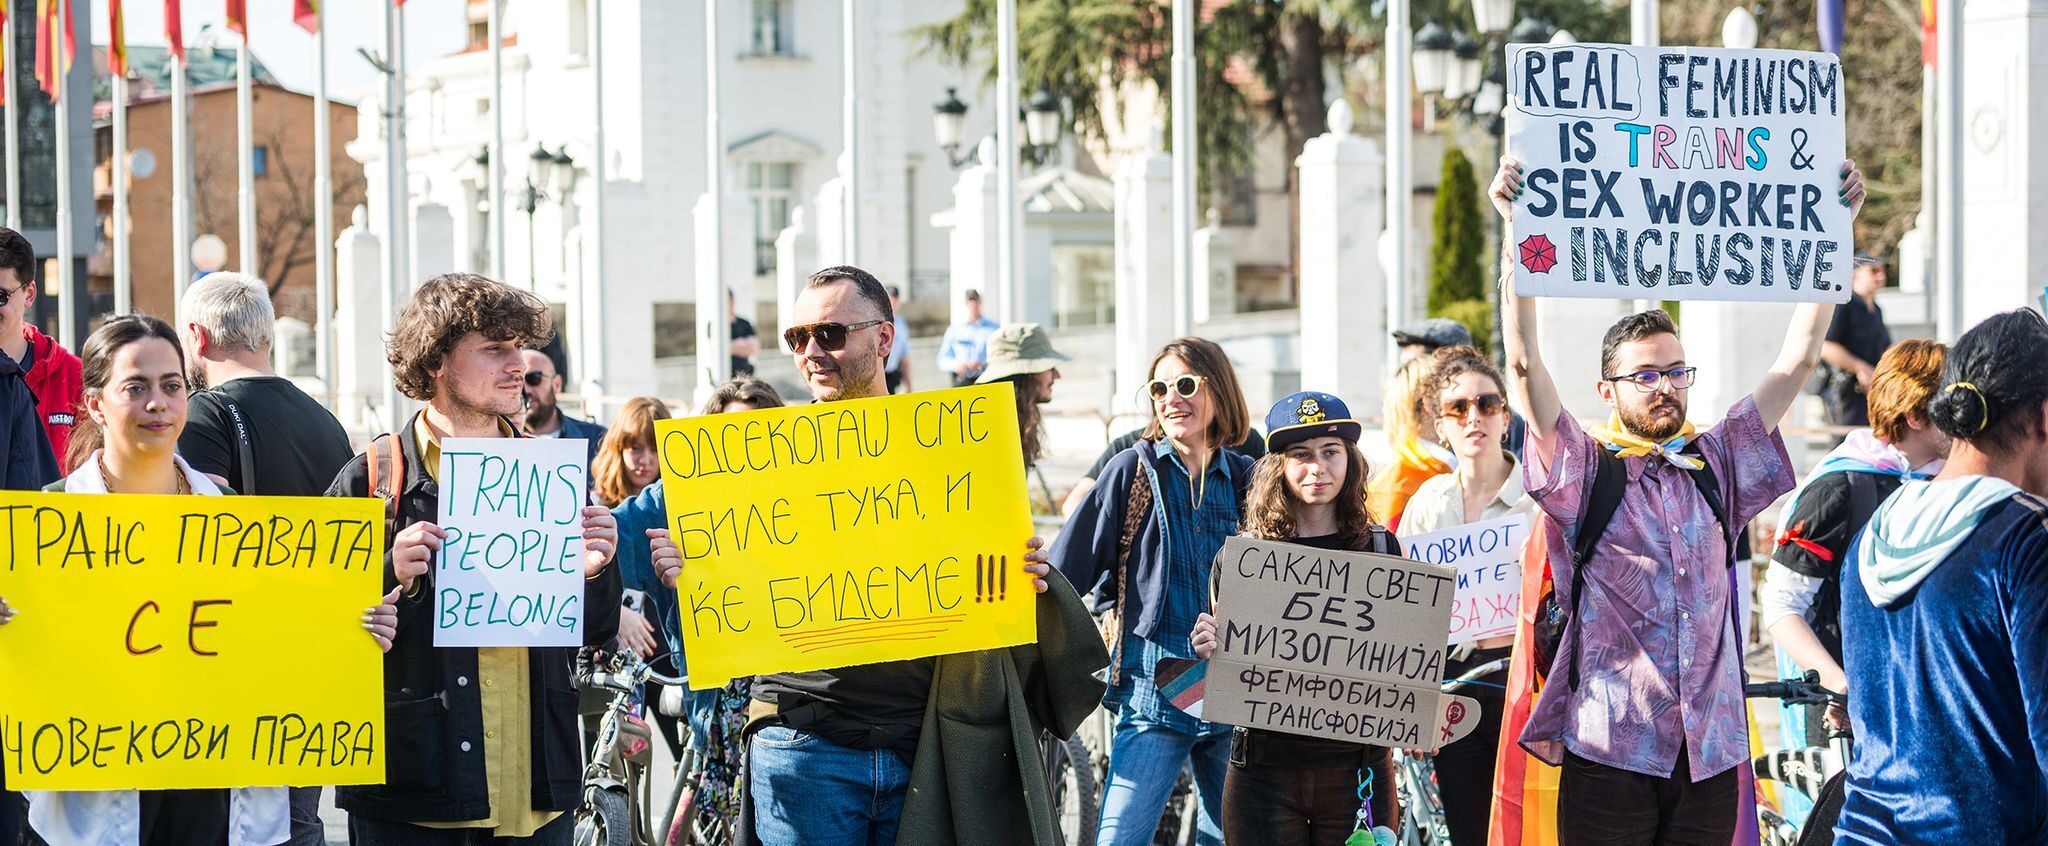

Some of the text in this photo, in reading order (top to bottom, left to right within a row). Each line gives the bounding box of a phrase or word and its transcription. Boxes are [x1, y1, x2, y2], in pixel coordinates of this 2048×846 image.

[1525, 51, 1838, 117] REAL FEMINISM
[1559, 120, 1816, 171] IS TRANS &
[1526, 168, 1826, 234] SEX WORKER
[1570, 226, 1843, 292] INCLUSIVE.
[663, 396, 989, 479] ОДСЕКОГАШ СМЕ
[442, 452, 582, 525] TRANS
[677, 471, 972, 560] БИЛЕ ТУКА, И
[0, 505, 375, 571] ТРАНС ПРАВАТА
[442, 527, 581, 573] PEOPLE
[1237, 546, 1453, 607] САКАМ СВЕТ
[439, 588, 577, 633] BELONG
[1281, 591, 1375, 632] БЕЗ
[1224, 619, 1443, 683] МИЗОГИНИЈА
[1239, 664, 1416, 713] ФЕМФОБИЈА
[5, 713, 374, 774] ЧОВЕКОВИ ПРАВА
[1244, 700, 1420, 745] ТРАНСФОБИЈА
